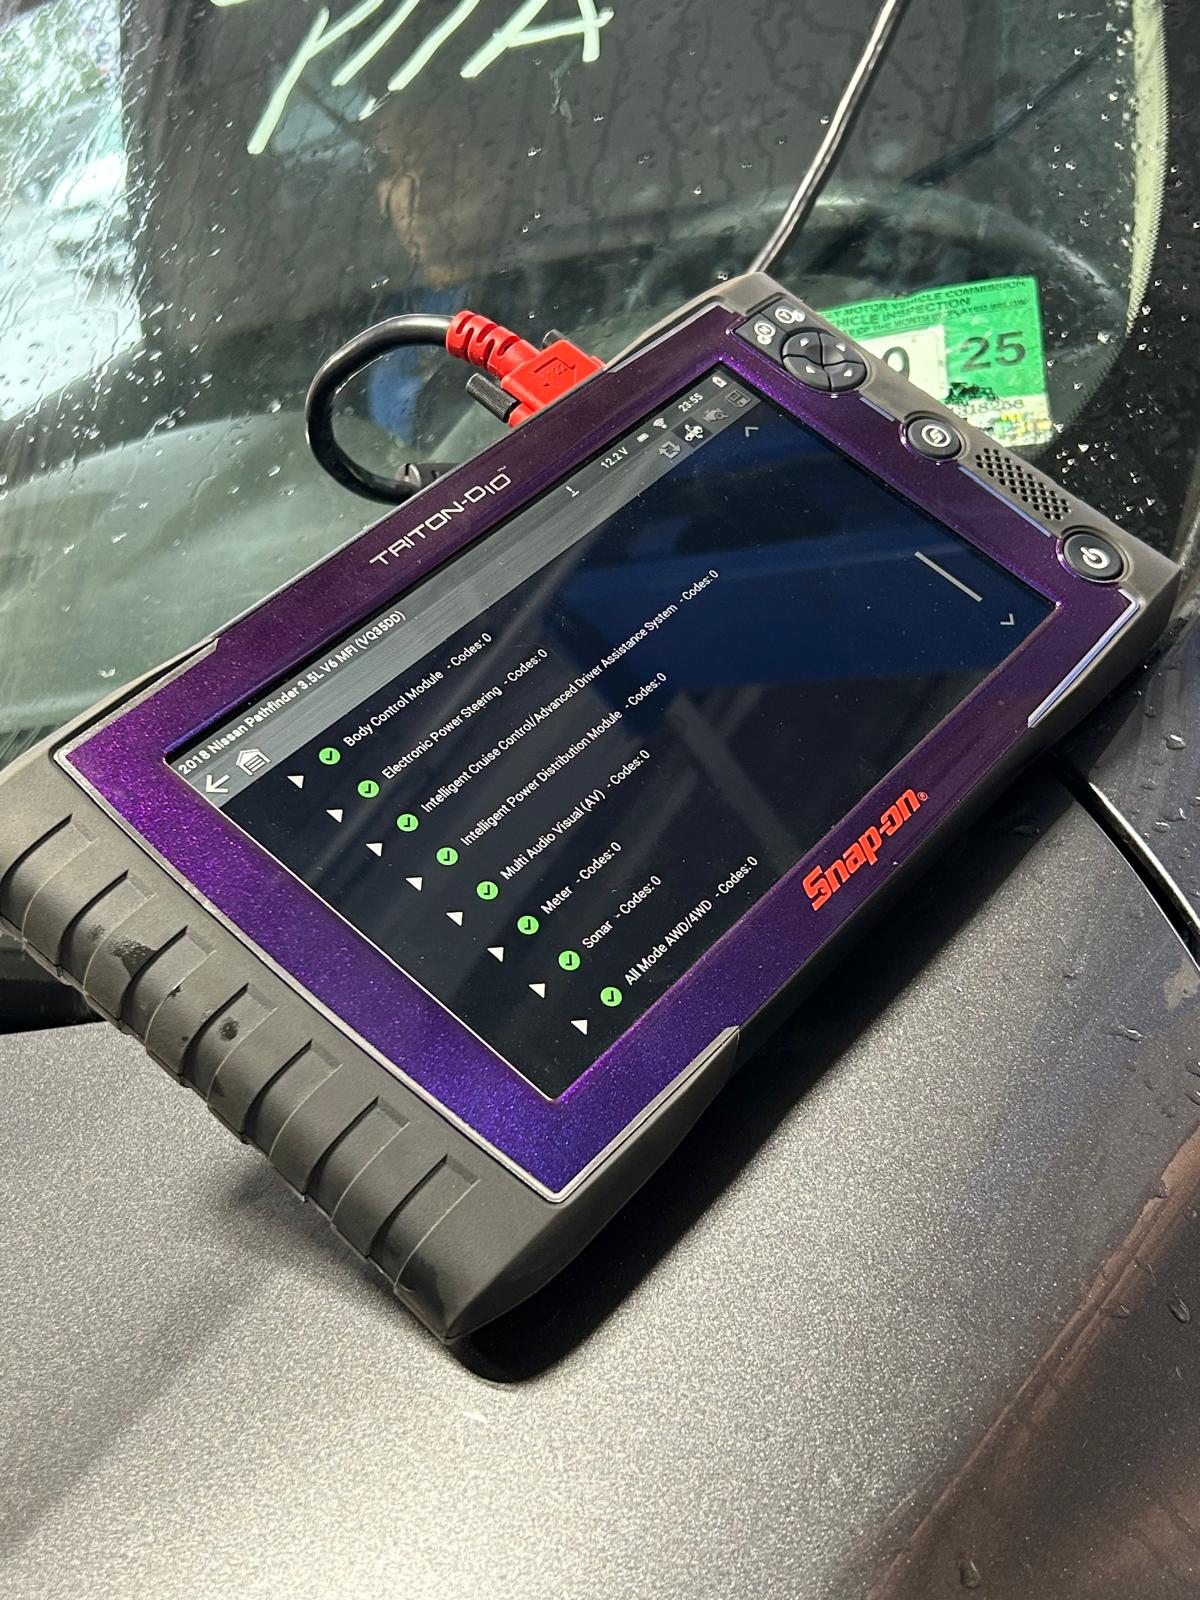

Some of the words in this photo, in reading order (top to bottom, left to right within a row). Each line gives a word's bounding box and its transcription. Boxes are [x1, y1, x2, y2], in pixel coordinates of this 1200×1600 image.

[843, 303, 889, 315] MOTOR
[945, 281, 1026, 299] COMMISSION
[882, 297, 971, 322] INSPECTION
[960, 331, 1026, 373] 25
[678, 392, 704, 413] 23:55
[600, 452, 624, 470] 12.2
[618, 446, 629, 458] V
[178, 751, 211, 775] 2018
[208, 723, 248, 754] Nissan
[247, 685, 301, 728] Pathfinder
[297, 669, 325, 691] 3.5L
[320, 657, 339, 674] V6
[335, 644, 360, 670] MFI
[355, 609, 407, 651] (VQ35DD)
[343, 723, 373, 747] Body
[370, 695, 410, 726] Control
[404, 671, 444, 701] Module
[421, 771, 472, 813] Intelligent
[468, 748, 501, 774] Cruise
[498, 683, 579, 750] Control/Advanced
[574, 665, 603, 688] Driver
[601, 629, 648, 668] Assistance
[644, 604, 678, 631] System
[381, 739, 433, 779] Electronic
[429, 715, 464, 742] Power
[460, 686, 503, 718] Steering
[460, 804, 511, 846] Intelligent
[506, 779, 540, 808] Power
[536, 738, 591, 782] Distribution
[586, 711, 623, 741] Module
[500, 854, 530, 880] Multi
[526, 833, 556, 859] Audio
[551, 806, 585, 834] Visual
[580, 789, 606, 812] (AV)
[802, 788, 921, 911] Snap-on
[540, 886, 573, 914] Meter
[582, 920, 614, 949] Sonar
[625, 967, 642, 986] All
[636, 944, 668, 973] Mode
[664, 900, 712, 947] AWD/4WD
